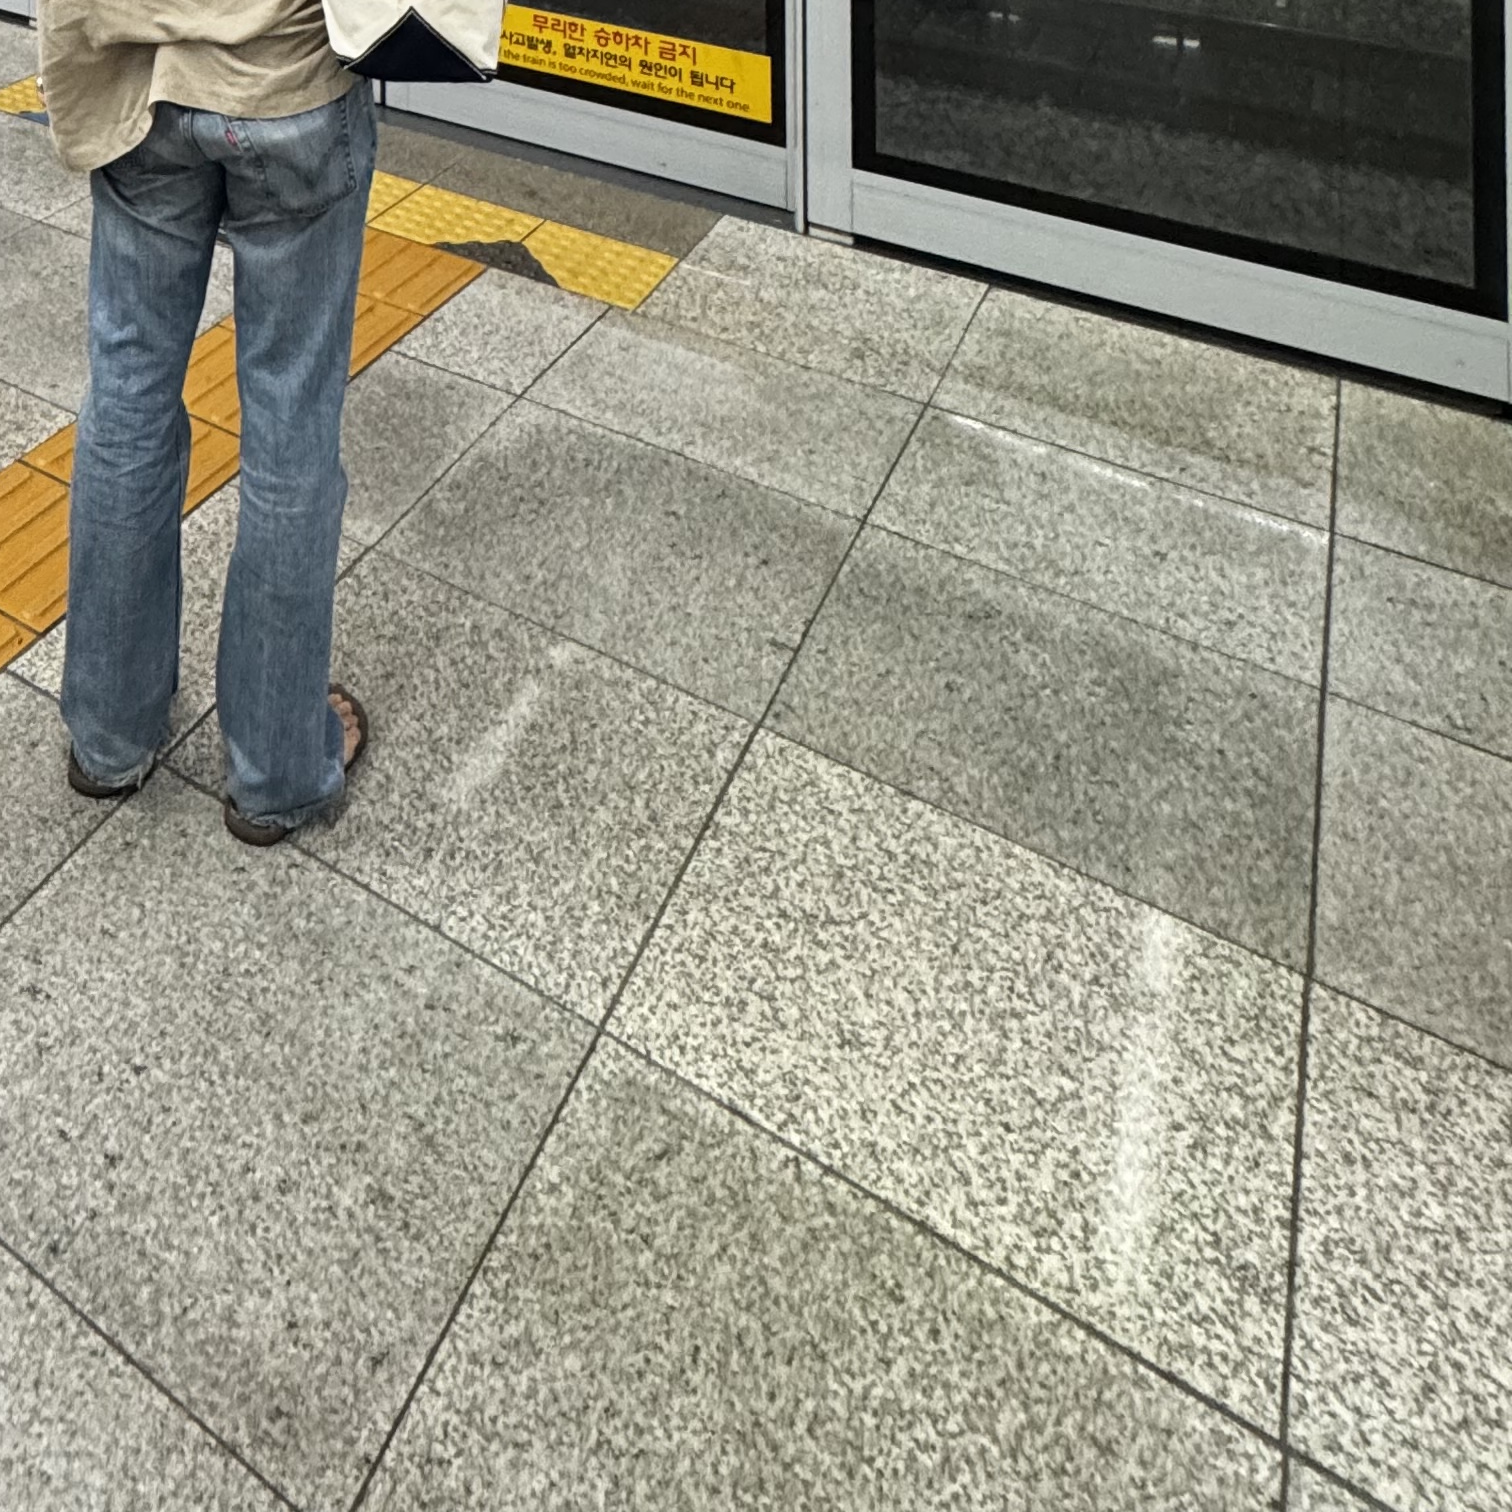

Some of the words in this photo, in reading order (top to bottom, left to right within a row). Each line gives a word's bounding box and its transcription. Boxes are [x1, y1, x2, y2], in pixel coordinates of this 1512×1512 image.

[532, 14, 587, 42] 무리한
[593, 27, 651, 56] 승하차
[658, 40, 697, 65] 금지
[503, 48, 520, 61] the
[522, 52, 546, 68] train
[548, 58, 557, 70] is
[558, 61, 578, 75] too
[630, 78, 656, 92] wait
[657, 82, 674, 96] for
[676, 86, 695, 102] the
[697, 92, 724, 108] next
[726, 99, 751, 113] one
[563, 43, 632, 72] 열차지연의
[638, 59, 684, 82] 원인이
[689, 70, 736, 93] 됩니다
